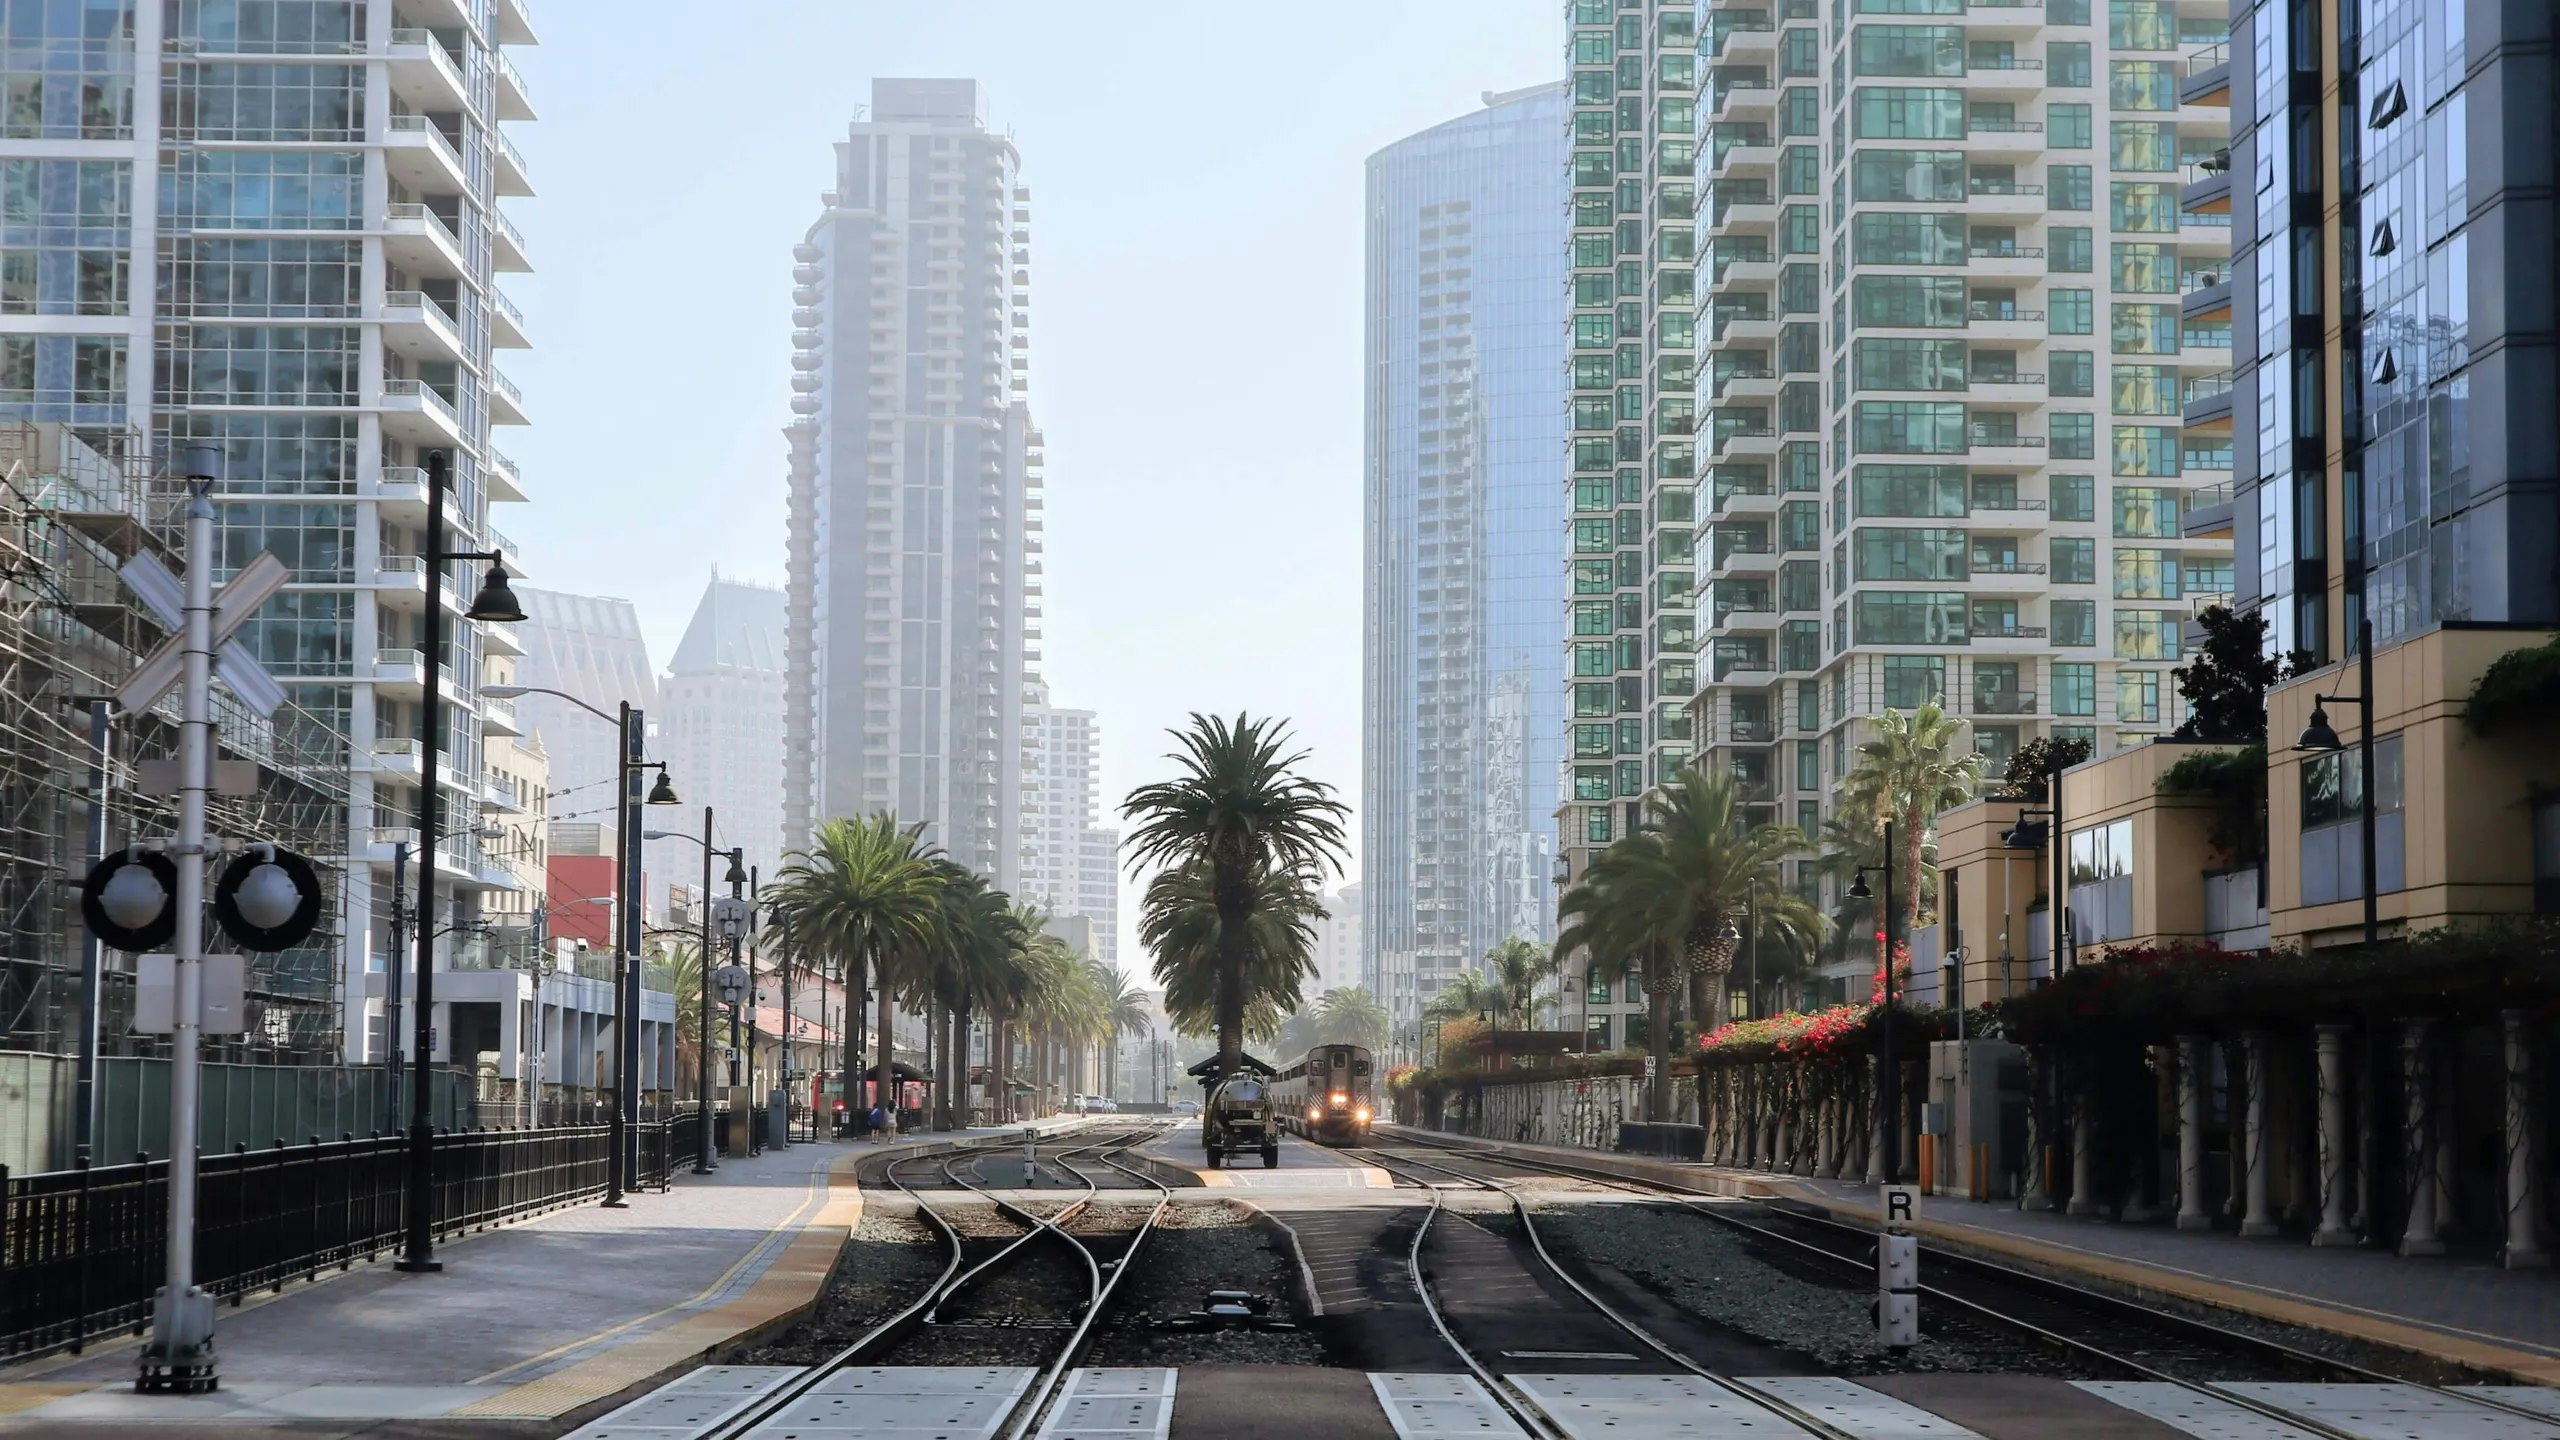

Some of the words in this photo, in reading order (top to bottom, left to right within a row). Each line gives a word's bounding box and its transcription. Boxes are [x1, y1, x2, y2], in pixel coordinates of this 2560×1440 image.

[725, 1050, 733, 1058] R
[1646, 1057, 1655, 1065] W
[1026, 1130, 1034, 1139] R
[1889, 1192, 1912, 1220] R
